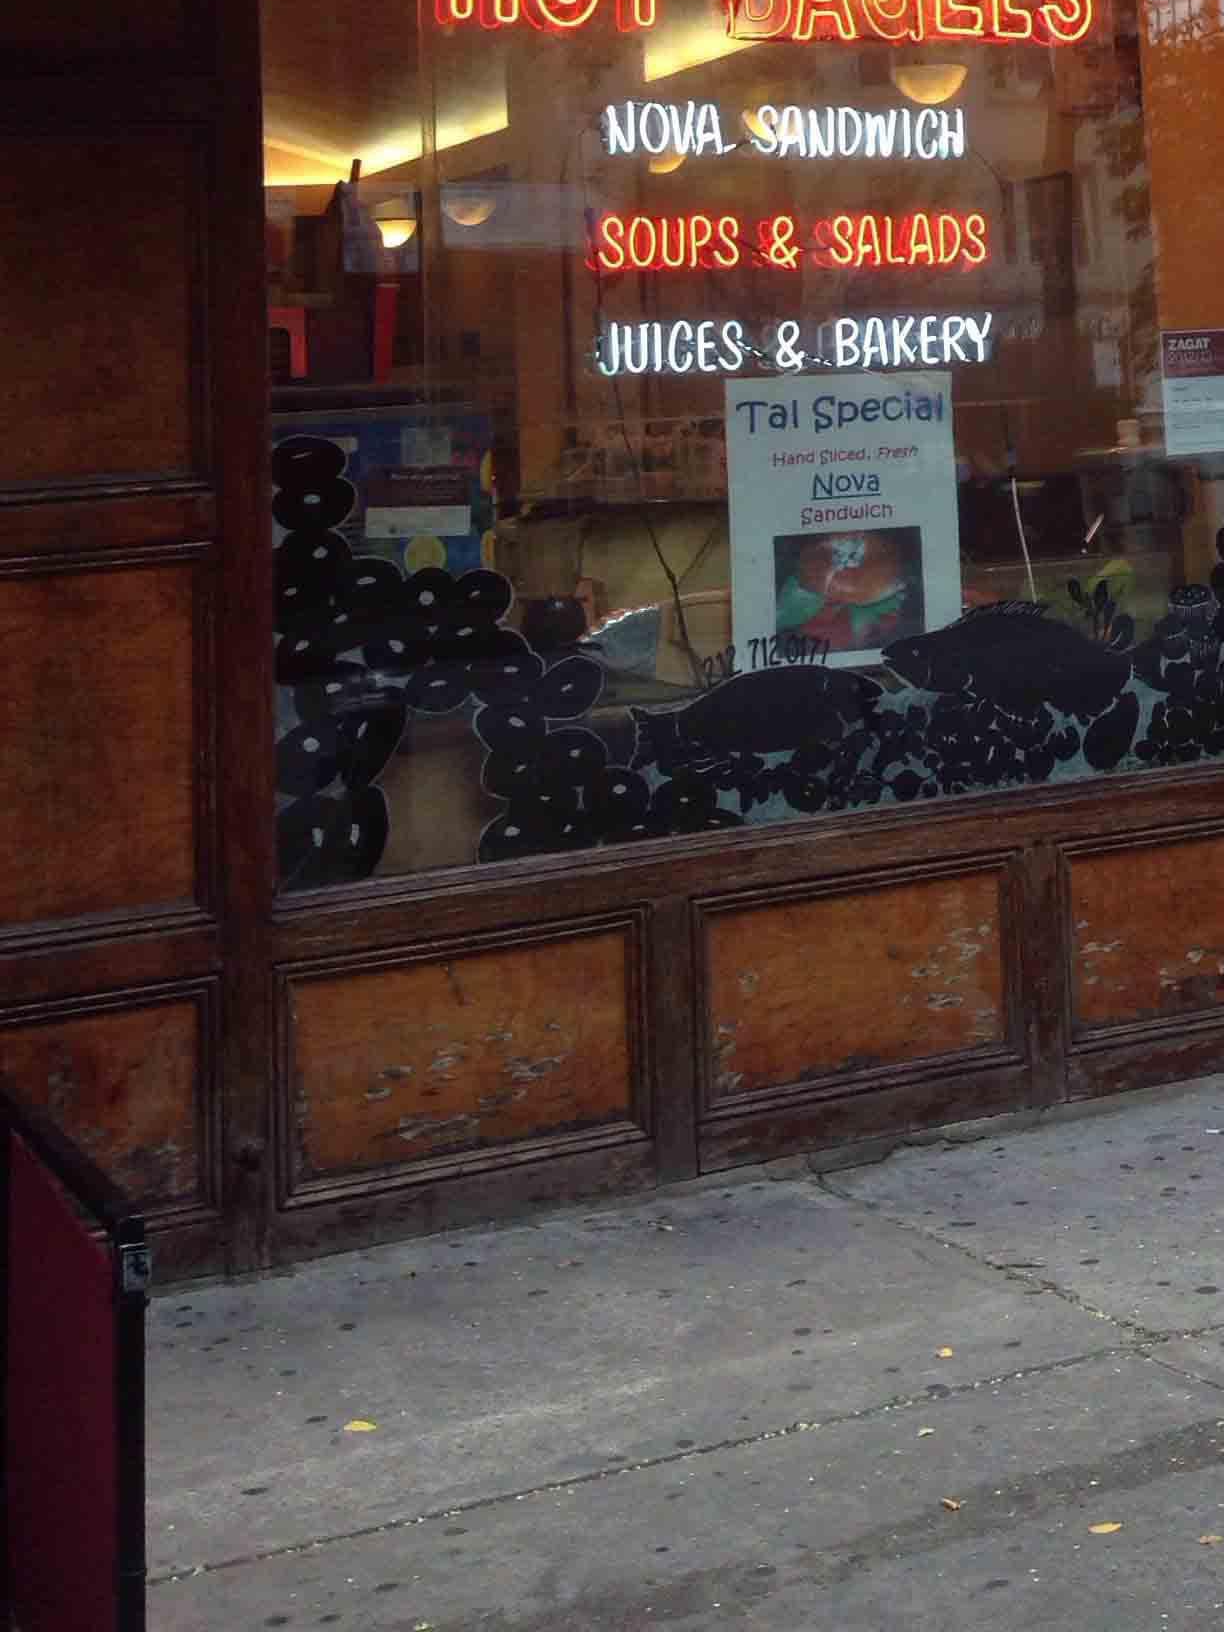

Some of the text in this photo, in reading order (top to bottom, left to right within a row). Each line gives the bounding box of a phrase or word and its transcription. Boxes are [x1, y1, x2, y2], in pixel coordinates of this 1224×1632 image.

[605, 100, 967, 160] NOVA SANDWICH
[598, 212, 988, 269] SOUPS & SALADS
[597, 311, 994, 377] JUICES & BAKERY
[1167, 336, 1211, 351] ZAGAT
[735, 390, 945, 434] Tal Special
[772, 450, 816, 468] Hand
[877, 444, 919, 460] Fresh
[811, 470, 882, 500] Nova
[799, 502, 894, 528] Sandwich
